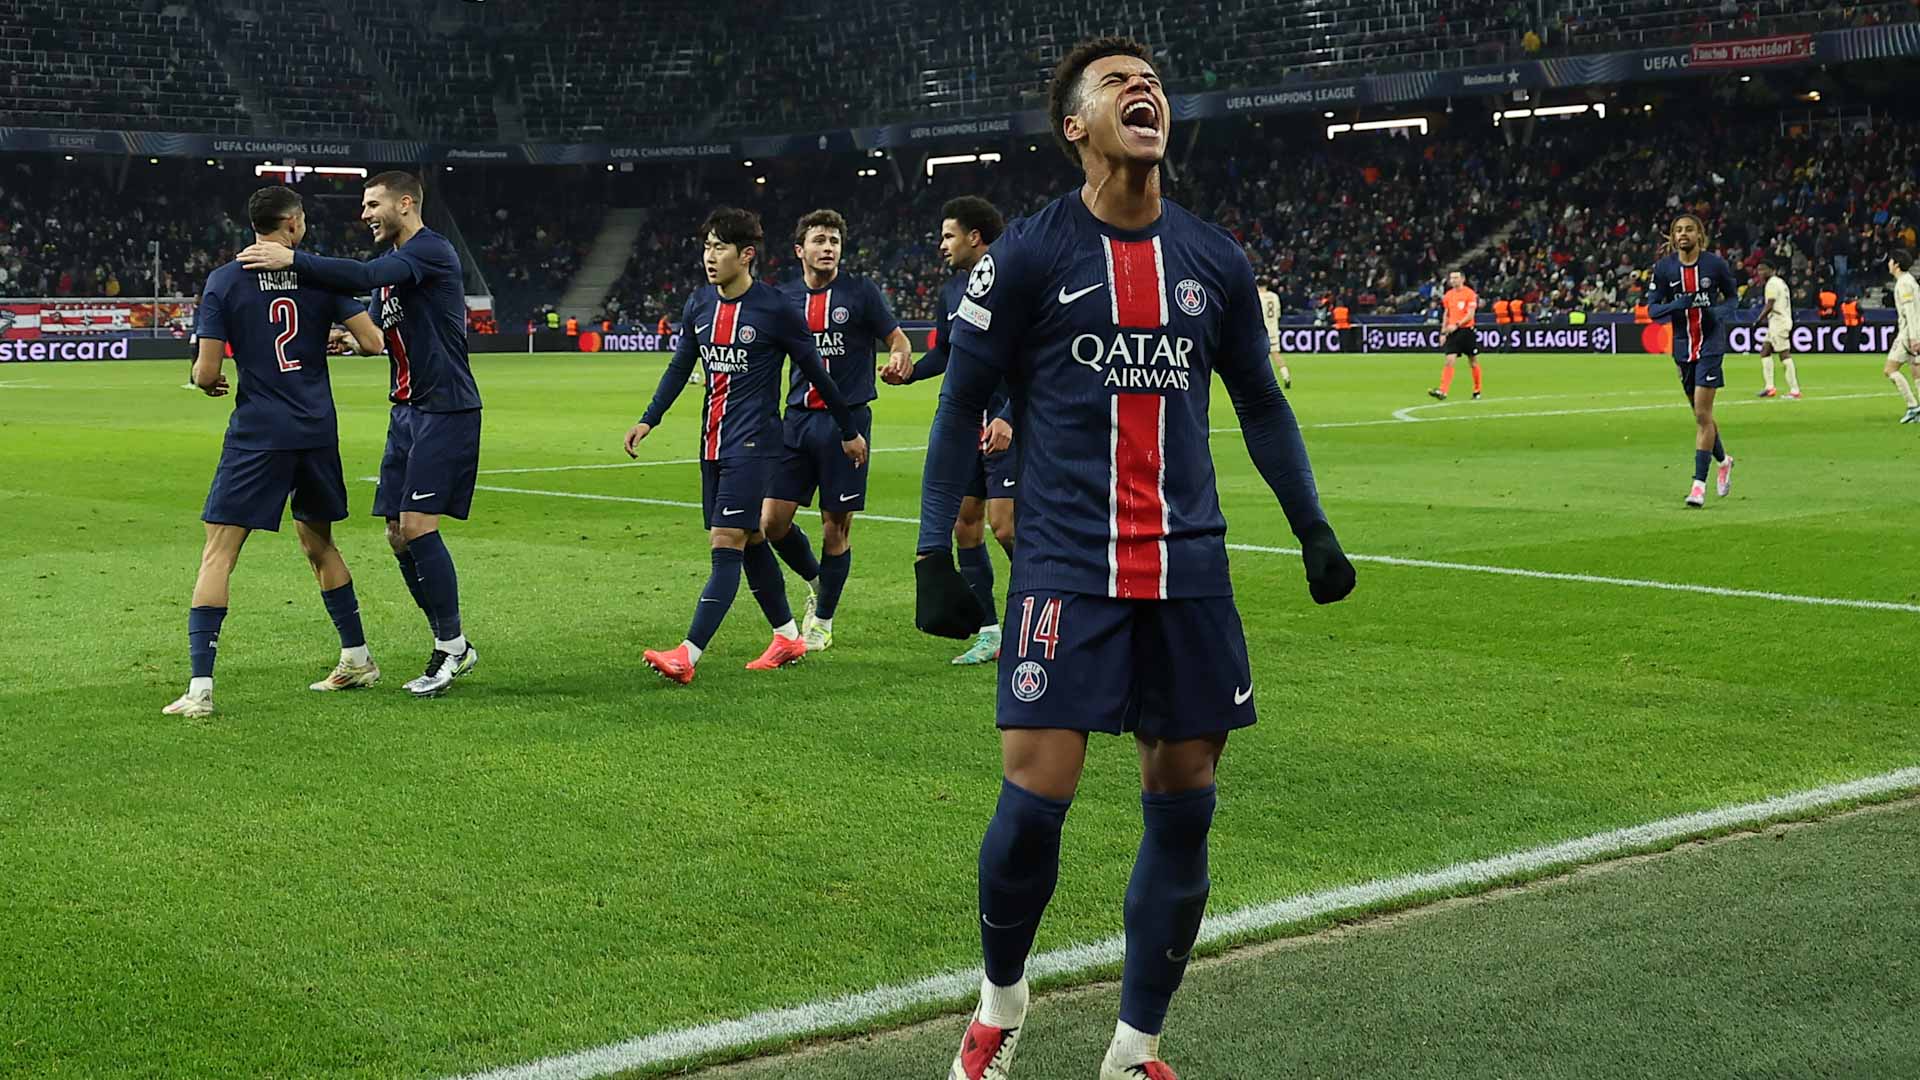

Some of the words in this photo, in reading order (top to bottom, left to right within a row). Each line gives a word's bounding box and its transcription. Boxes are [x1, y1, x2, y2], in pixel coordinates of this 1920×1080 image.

[1643, 56, 1677, 71] UEFA
[1226, 97, 1252, 109] UEFA
[1254, 90, 1313, 107] CHAMPIONS
[1315, 86, 1356, 101] LEAGUE
[911, 127, 931, 138] UEFA
[932, 122, 977, 136] CHAMPIONS
[979, 119, 1009, 132] LEAGUE
[213, 141, 242, 151] UEFA
[245, 142, 308, 153] CHAMPIONS
[310, 145, 350, 155] LEAGUE
[610, 148, 639, 158] UEFA
[641, 146, 695, 158] CHAMPIONS
[698, 144, 731, 155] LEAGUE
[269, 297, 302, 373] 2
[812, 332, 845, 347] TAR
[1386, 331, 1427, 347] UEFA
[1526, 331, 1588, 347] LEAGUE
[700, 345, 748, 364] QATAR
[1071, 333, 1194, 372] QATAR
[709, 361, 748, 373] AIRWAYS
[1104, 367, 1190, 391] AIRWAYS
[1018, 596, 1062, 660] 14
